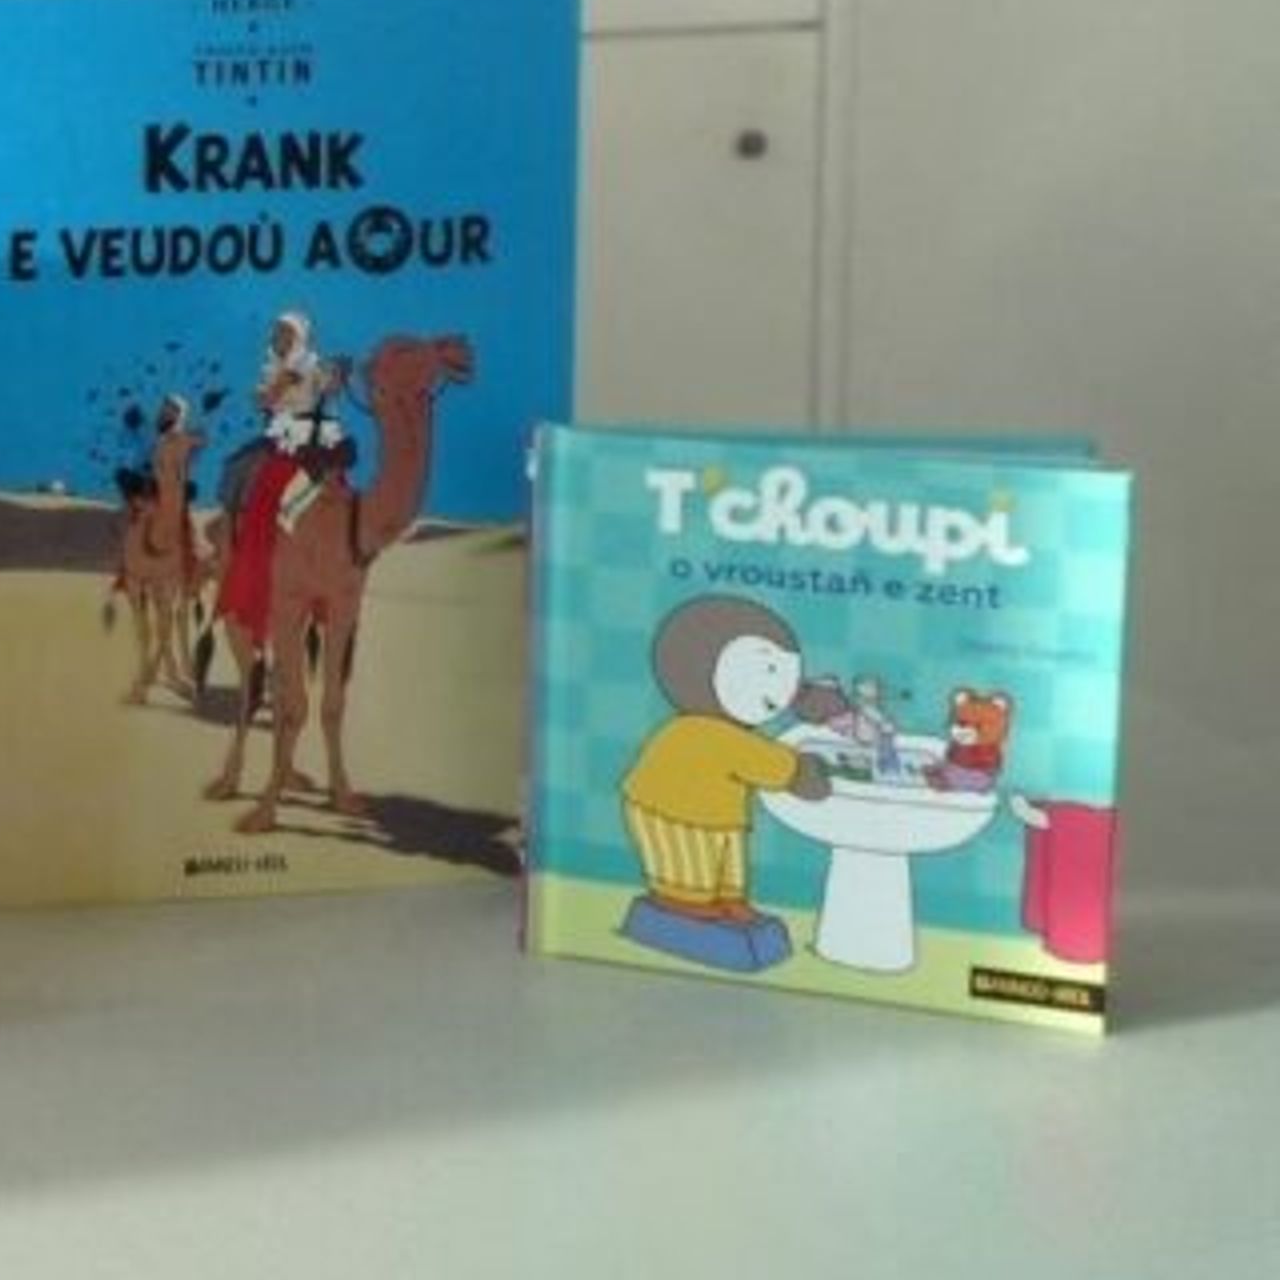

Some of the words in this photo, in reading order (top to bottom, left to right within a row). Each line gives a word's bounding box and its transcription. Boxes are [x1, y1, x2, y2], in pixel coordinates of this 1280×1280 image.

[192, 58, 314, 87] TINTIN
[144, 122, 365, 194] KRANK
[8, 228, 38, 282] E
[60, 212, 285, 280] VEUDOÙ
[644, 462, 1031, 577] T'choupi
[671, 558, 690, 579] o
[883, 577, 905, 600] e
[915, 582, 1002, 610] zent
